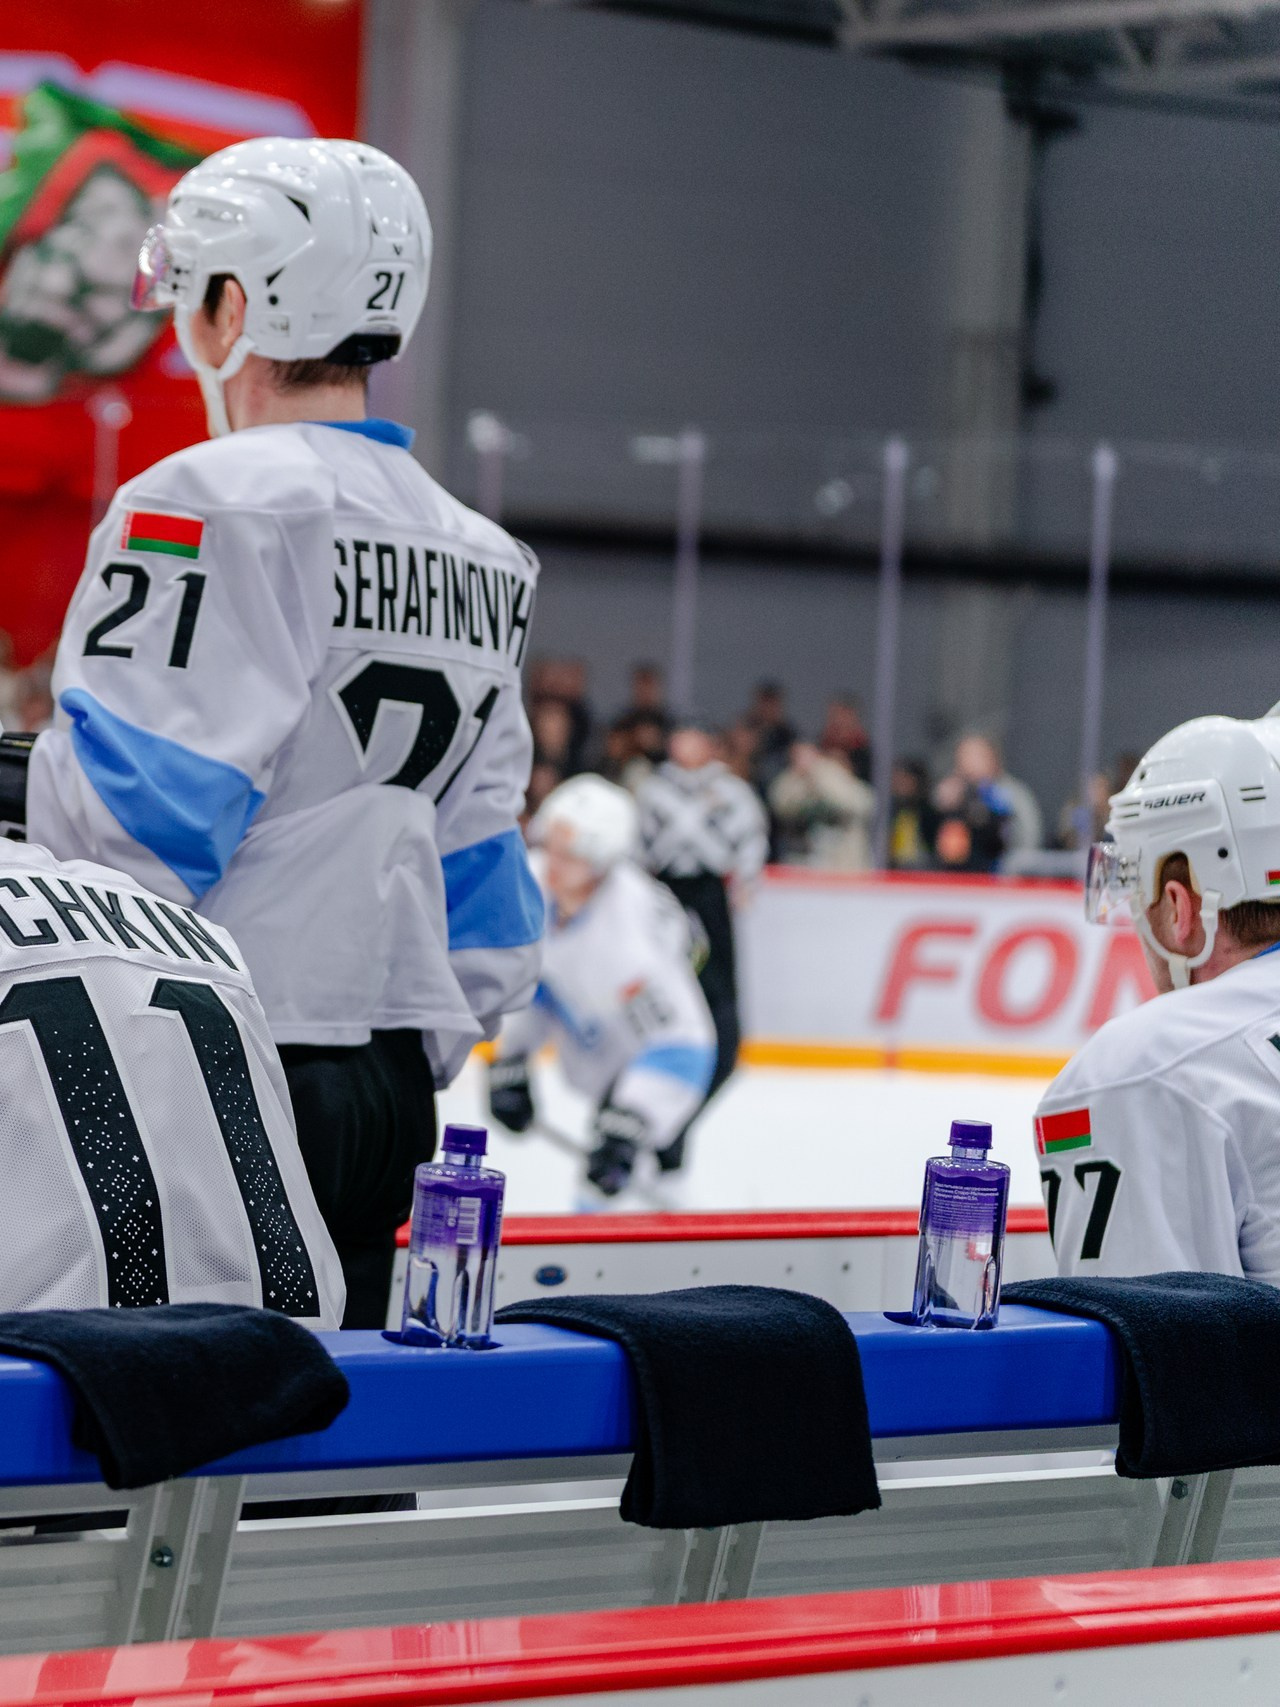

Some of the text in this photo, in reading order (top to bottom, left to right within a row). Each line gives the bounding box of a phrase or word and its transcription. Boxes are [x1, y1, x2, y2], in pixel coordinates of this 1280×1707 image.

[366, 271, 406, 311] 21
[82, 563, 208, 669] 21
[1040, 1159, 1122, 1261] 77
